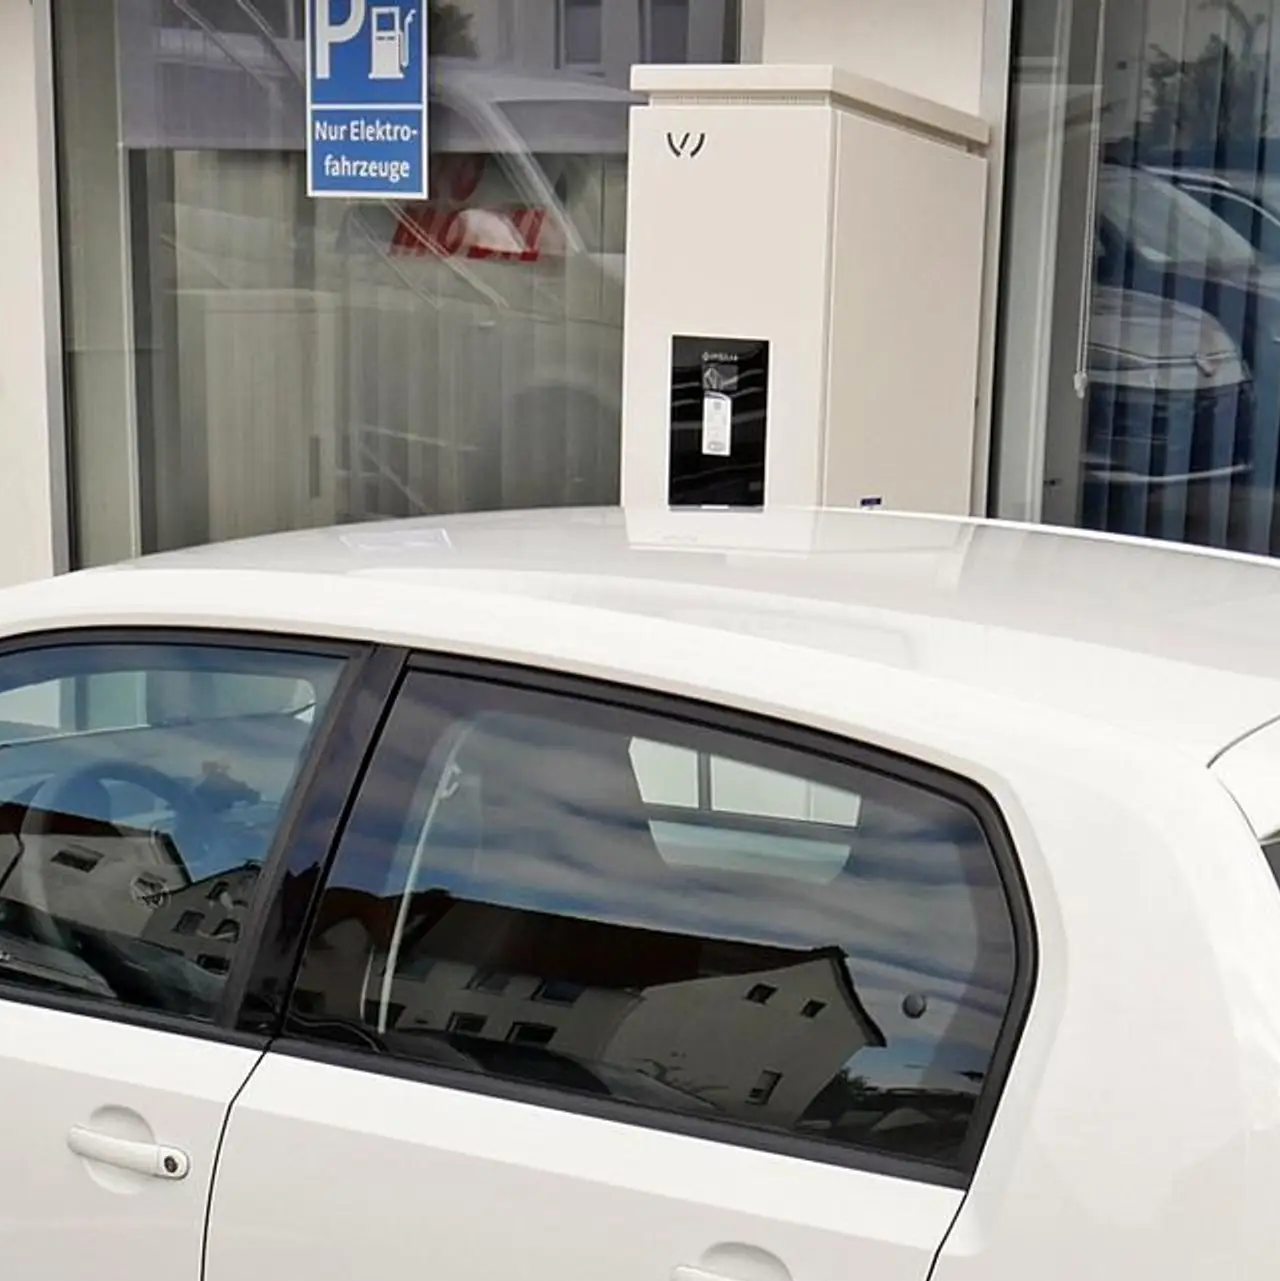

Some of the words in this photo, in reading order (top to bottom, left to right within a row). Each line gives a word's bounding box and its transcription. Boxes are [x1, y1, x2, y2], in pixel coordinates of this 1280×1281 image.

[315, 0, 366, 79] P
[315, 120, 348, 142] Nur
[350, 118, 418, 142] Elektro-
[324, 154, 410, 183] fahrzeuge
